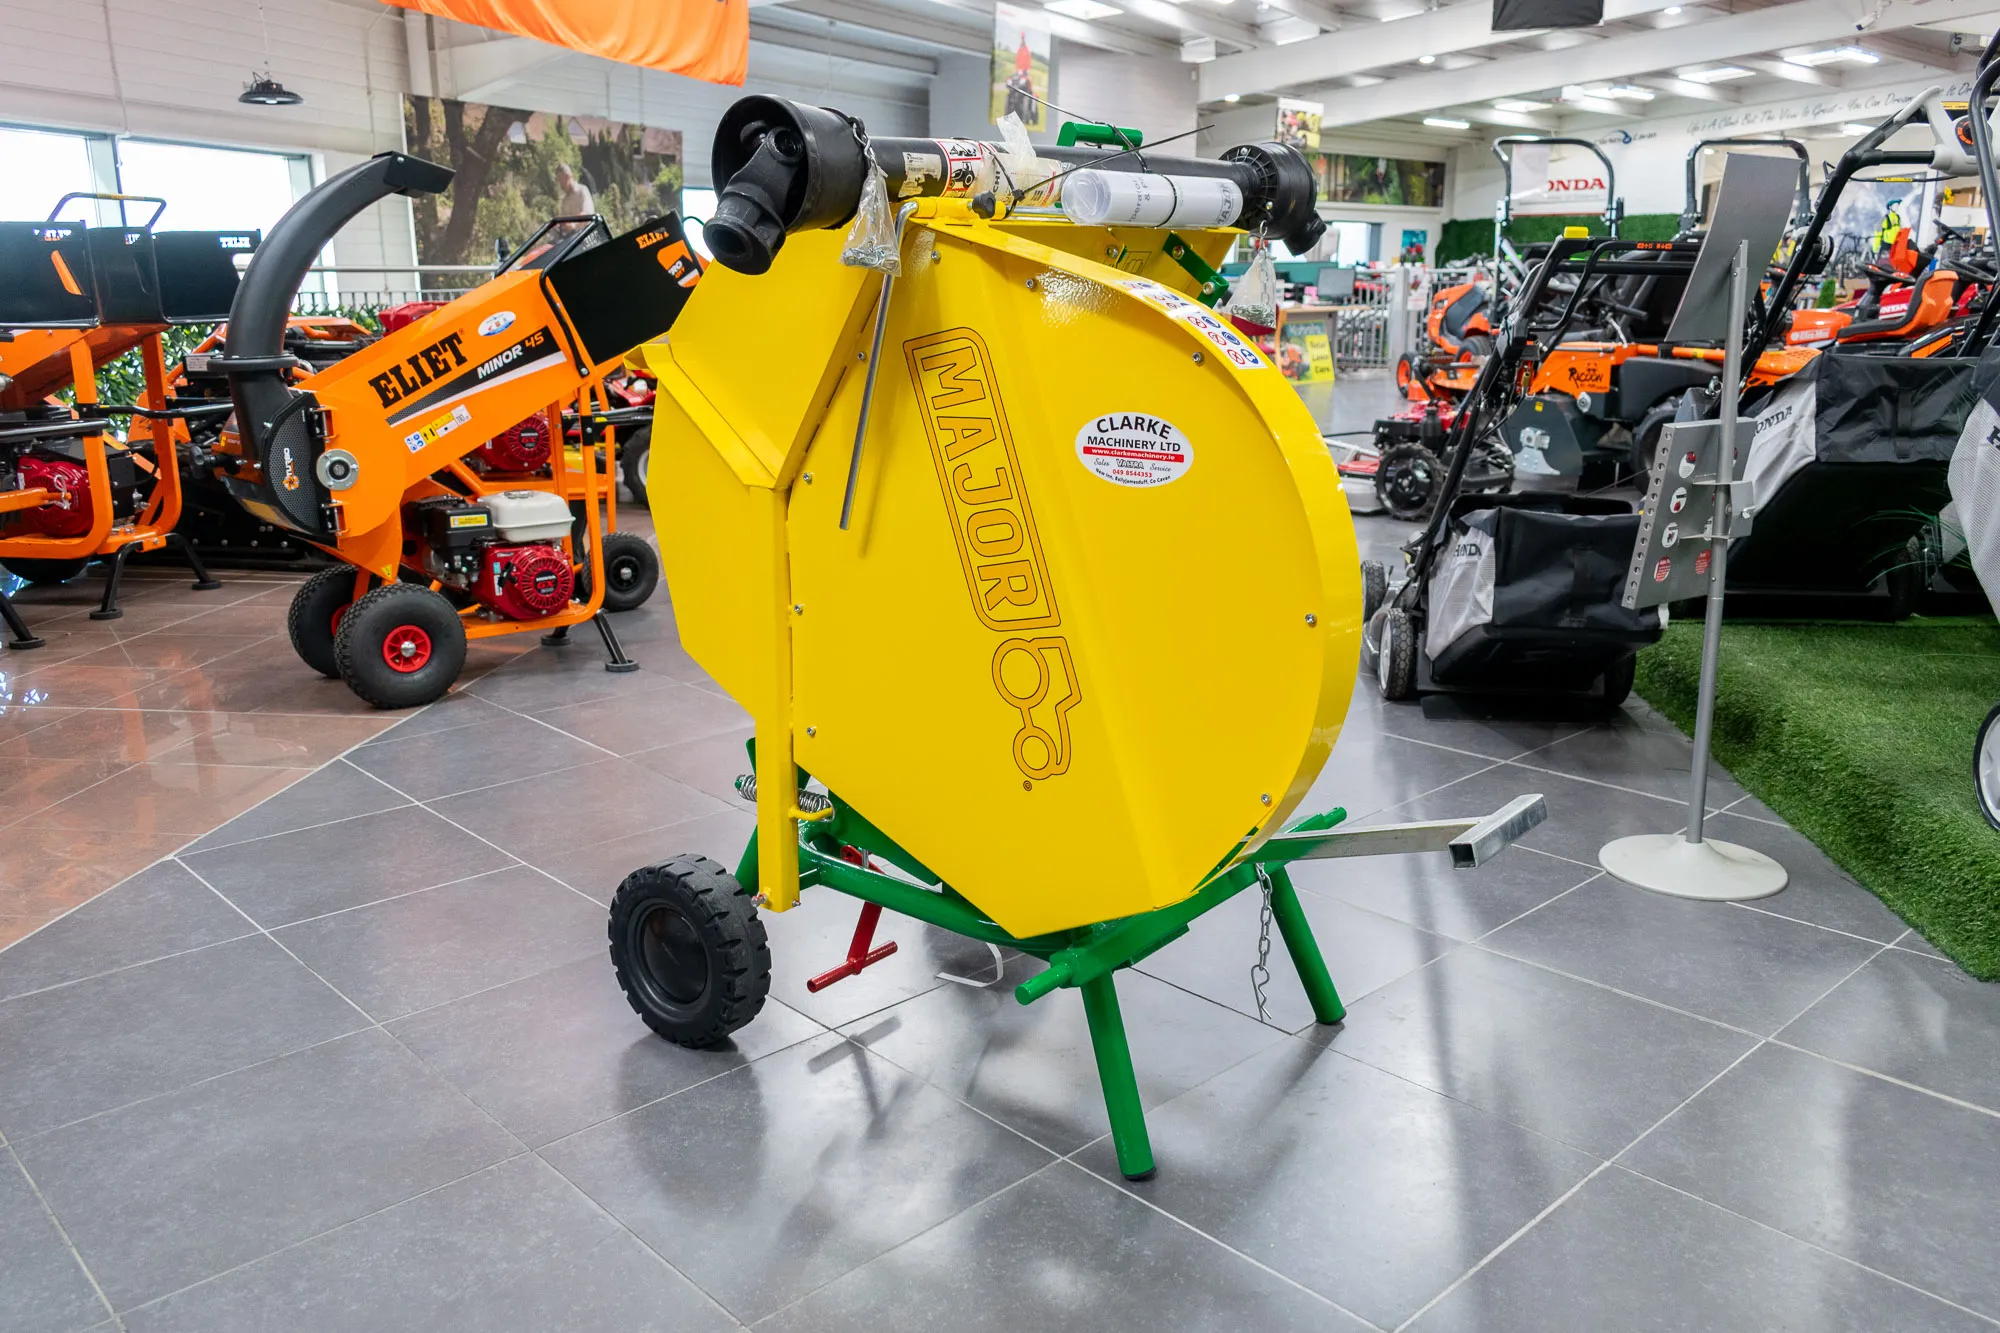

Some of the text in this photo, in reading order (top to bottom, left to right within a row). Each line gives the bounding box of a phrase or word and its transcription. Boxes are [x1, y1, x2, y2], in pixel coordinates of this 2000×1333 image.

[1548, 177, 1606, 191] ONDA
[476, 330, 545, 380] MINOR 45
[368, 331, 468, 409] ELIET
[1096, 415, 1172, 440] CLARKE
[1755, 405, 1793, 434] ONDA
[1087, 435, 1181, 452] MACHINERY LTD
[1091, 448, 1175, 461] www.clarkemachinery.ie
[1093, 457, 1171, 473] Sales VALTRA Service
[921, 346, 1039, 611] MAJOR
[1112, 468, 1153, 479] 049 8544353
